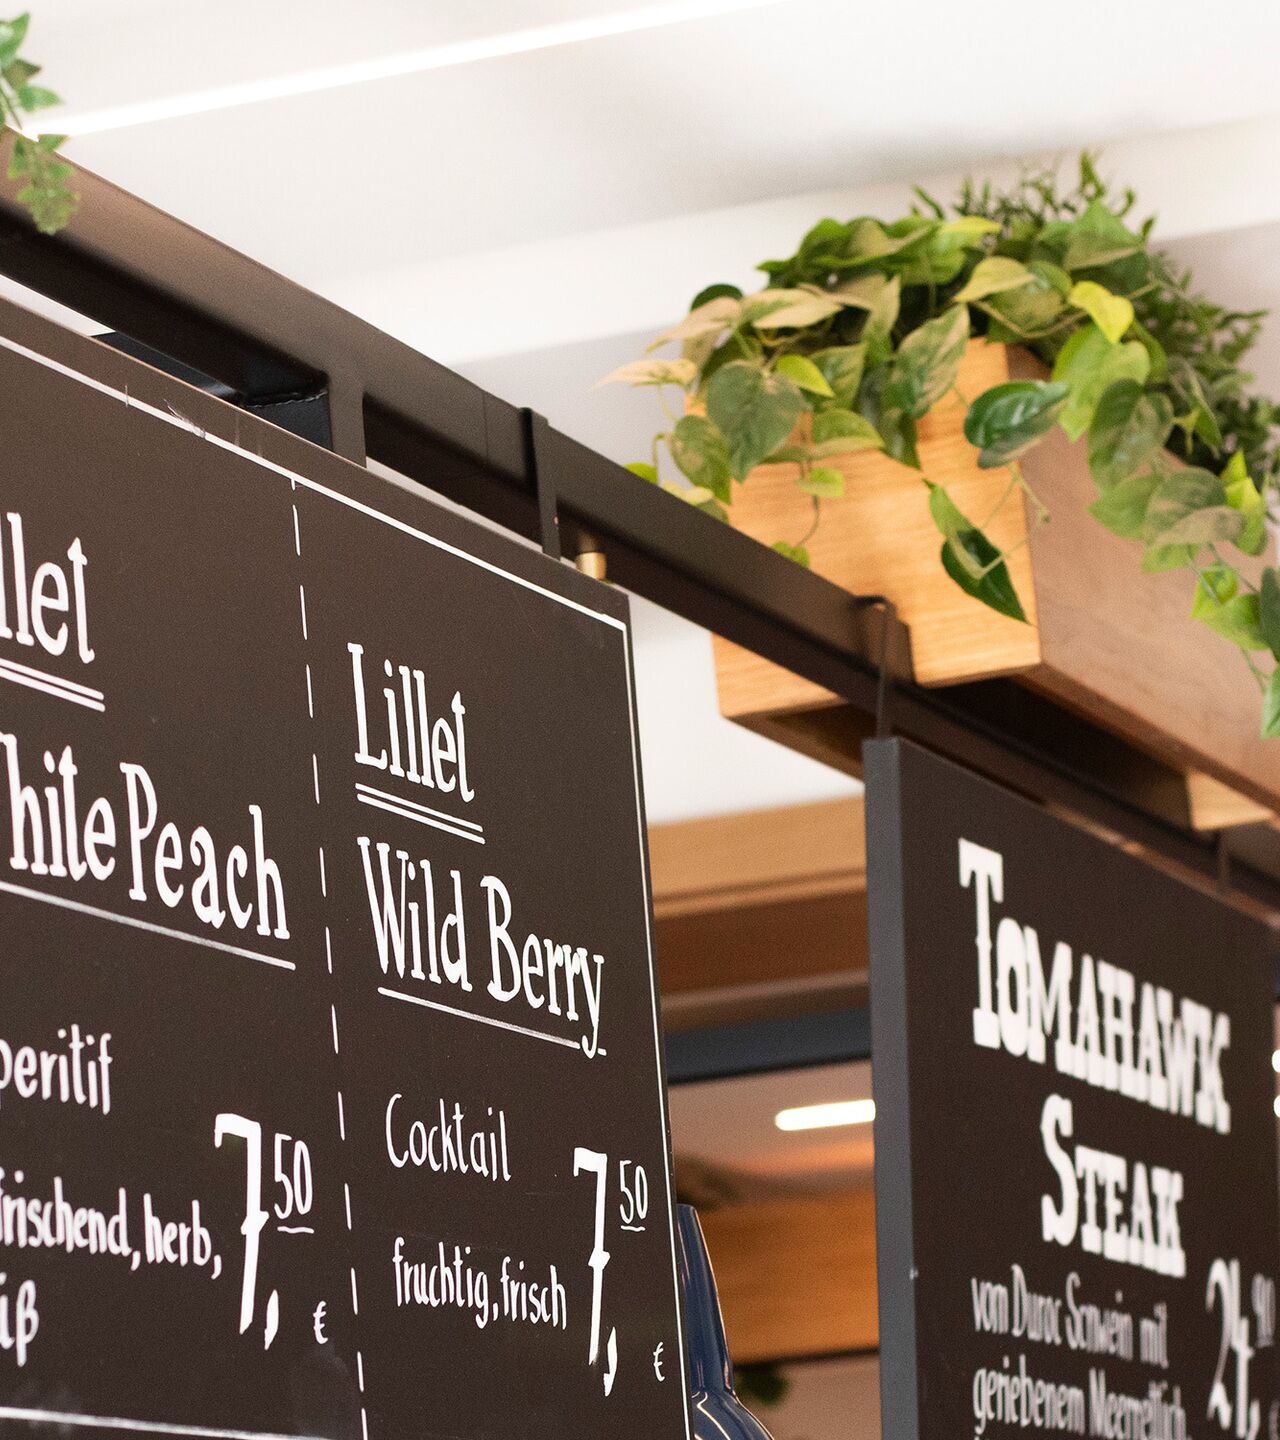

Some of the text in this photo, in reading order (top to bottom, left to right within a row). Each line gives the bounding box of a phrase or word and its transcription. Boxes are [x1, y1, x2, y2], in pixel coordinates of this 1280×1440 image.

[348, 643, 475, 803] Lillet
[120, 762, 291, 941] Peach
[357, 836, 605, 1059] Wild Berry
[385, 1093, 512, 1182] Cocktail
[143, 1192, 222, 1280] herb,
[500, 1256, 567, 1331] frisch
